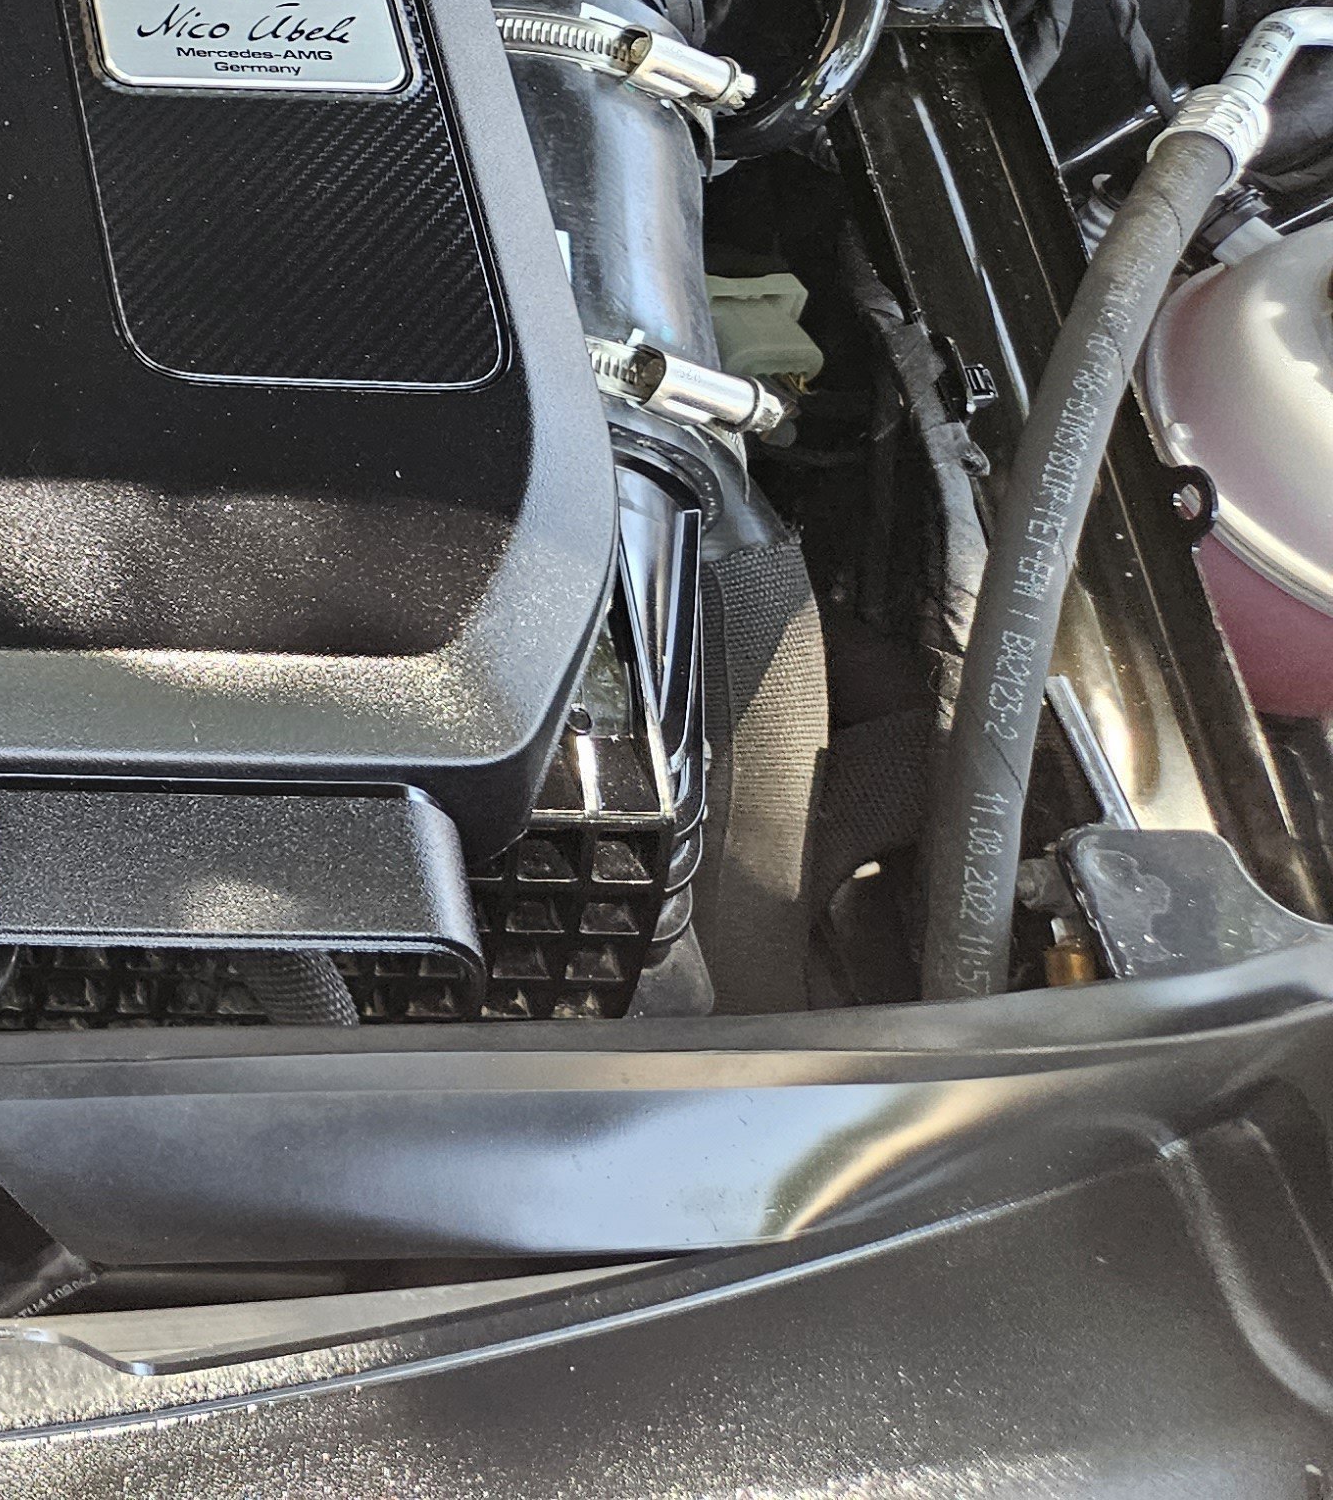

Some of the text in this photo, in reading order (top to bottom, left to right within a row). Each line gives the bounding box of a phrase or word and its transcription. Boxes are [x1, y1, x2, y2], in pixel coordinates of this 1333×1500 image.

[136, 2, 230, 40] Nico
[175, 46, 334, 61] Mercedes-AMG
[213, 61, 302, 76] Germany
[958, 792, 1010, 925] 11.08.2022
